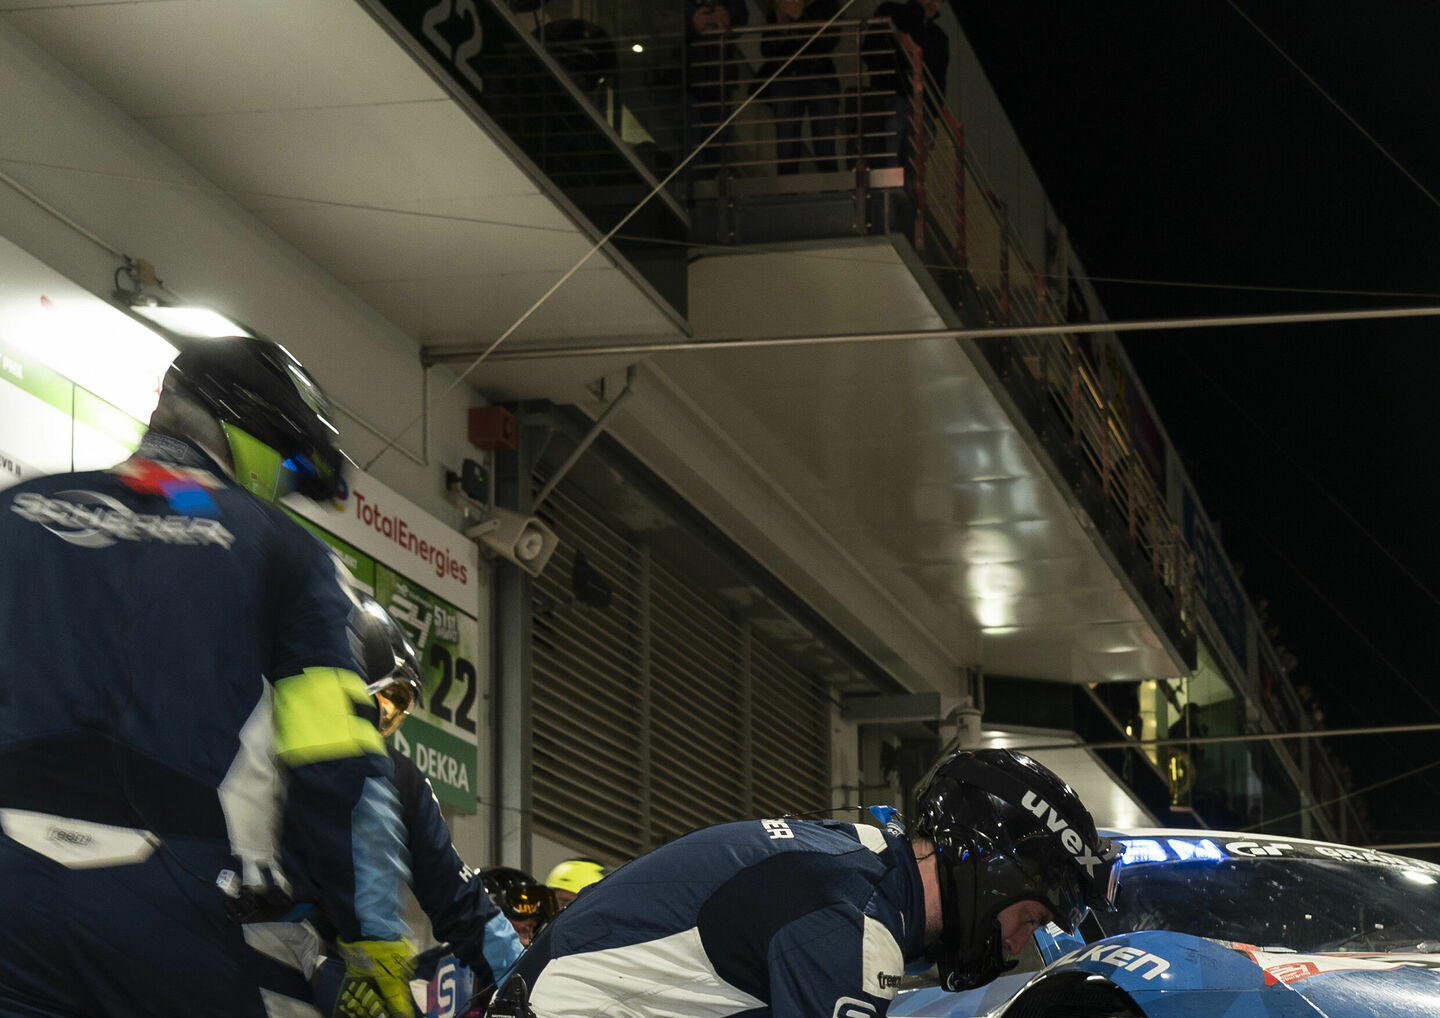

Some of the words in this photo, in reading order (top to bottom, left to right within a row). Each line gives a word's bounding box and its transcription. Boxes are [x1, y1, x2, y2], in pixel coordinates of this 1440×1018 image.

[352, 491, 468, 585] TotalEnergies
[416, 742, 470, 792] DEKRA
[1021, 790, 1103, 879] uvex
